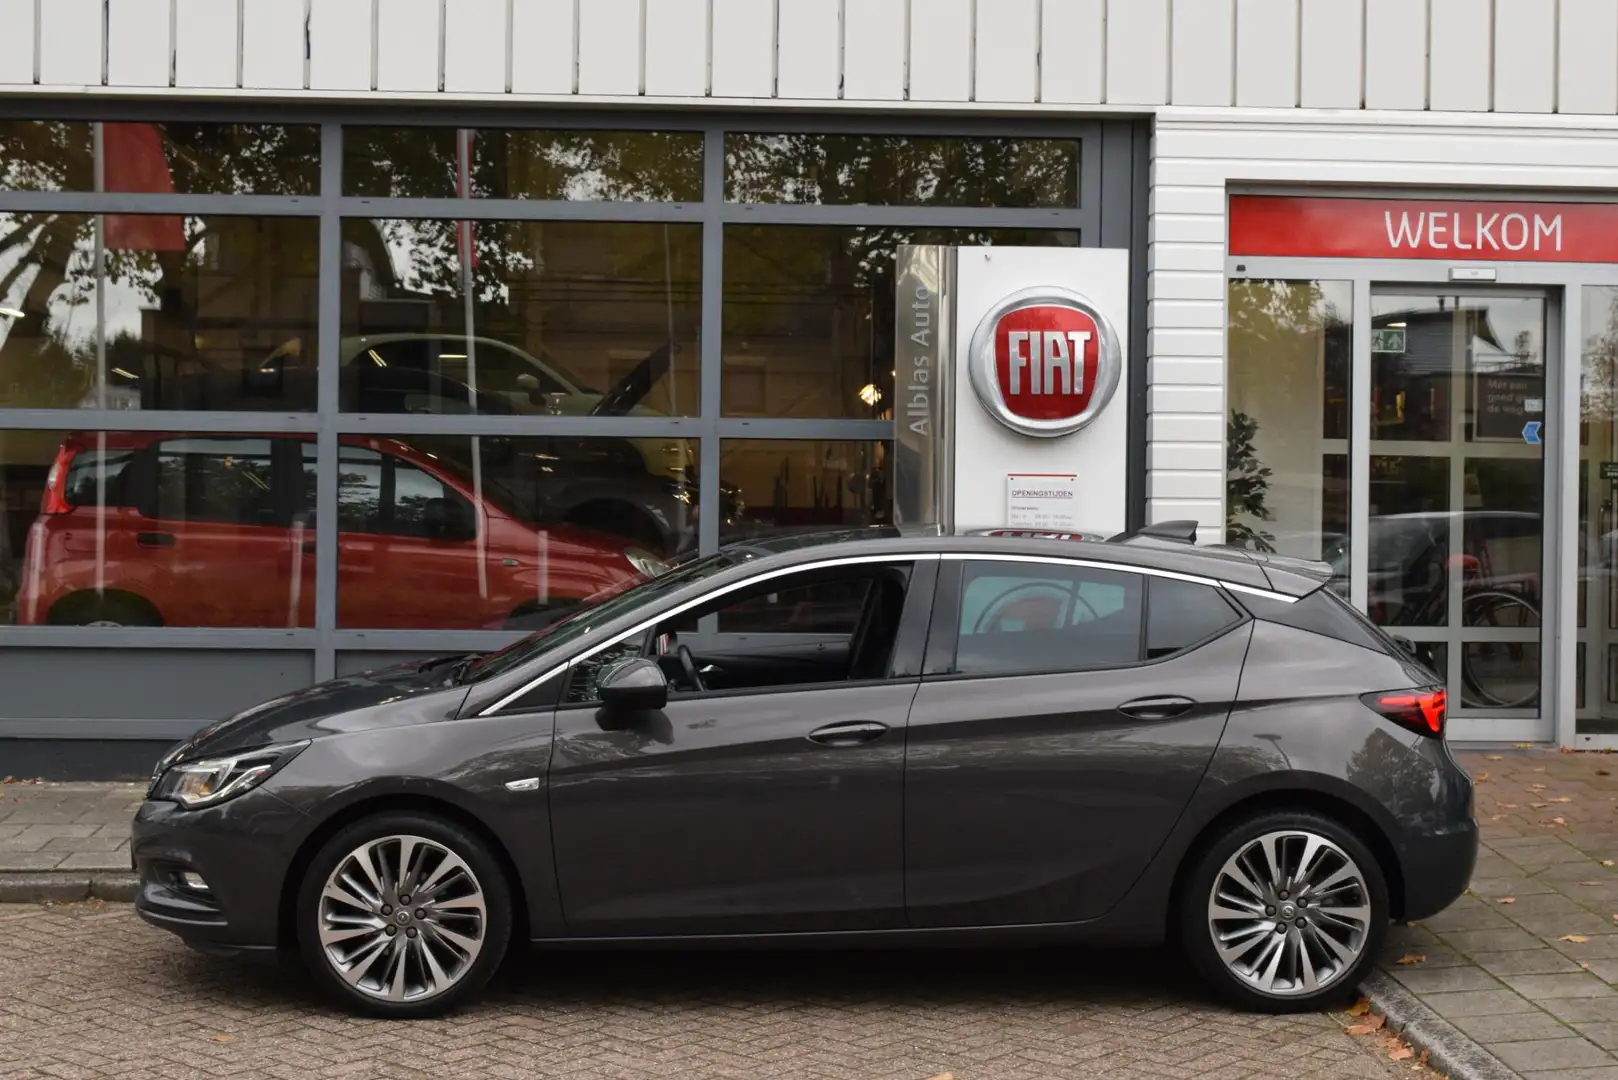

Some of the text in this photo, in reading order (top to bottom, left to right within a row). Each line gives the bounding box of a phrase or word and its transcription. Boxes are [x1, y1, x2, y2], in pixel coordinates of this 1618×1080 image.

[1384, 211, 1562, 251] WELKOM
[907, 285, 932, 436] Alblas Auto
[1008, 331, 1091, 395] FIAT
[1011, 489, 1073, 497] OPENINGSTIJDEN
